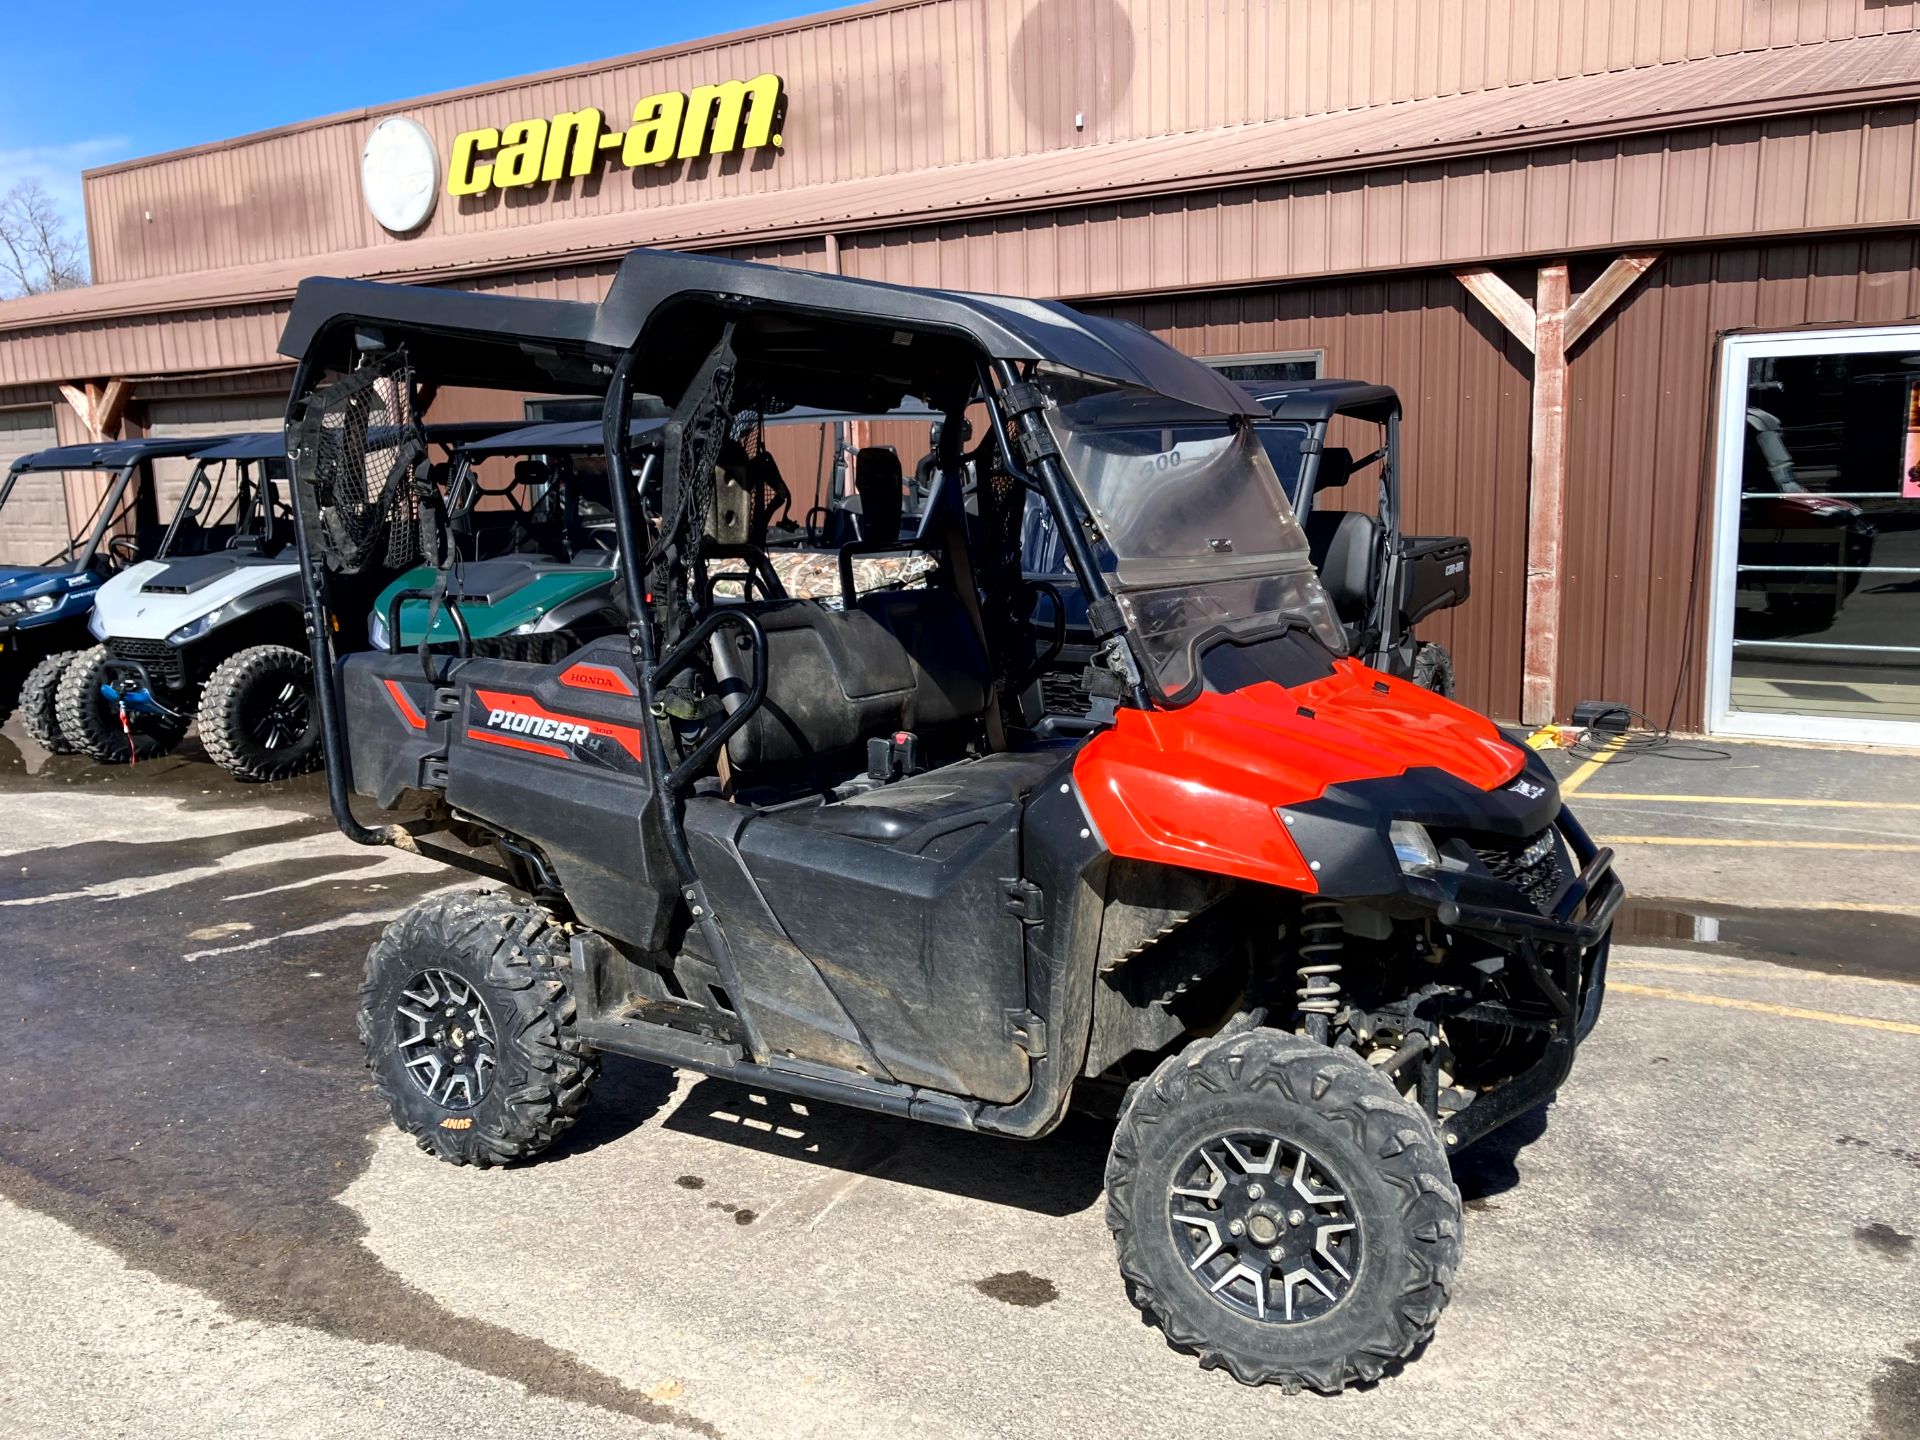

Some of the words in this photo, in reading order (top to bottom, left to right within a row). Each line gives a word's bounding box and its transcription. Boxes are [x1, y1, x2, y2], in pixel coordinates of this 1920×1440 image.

[447, 73, 780, 196] can-am
[570, 673, 614, 688] HONDA
[487, 708, 591, 746] PIONEER
[593, 726, 613, 735] 700
